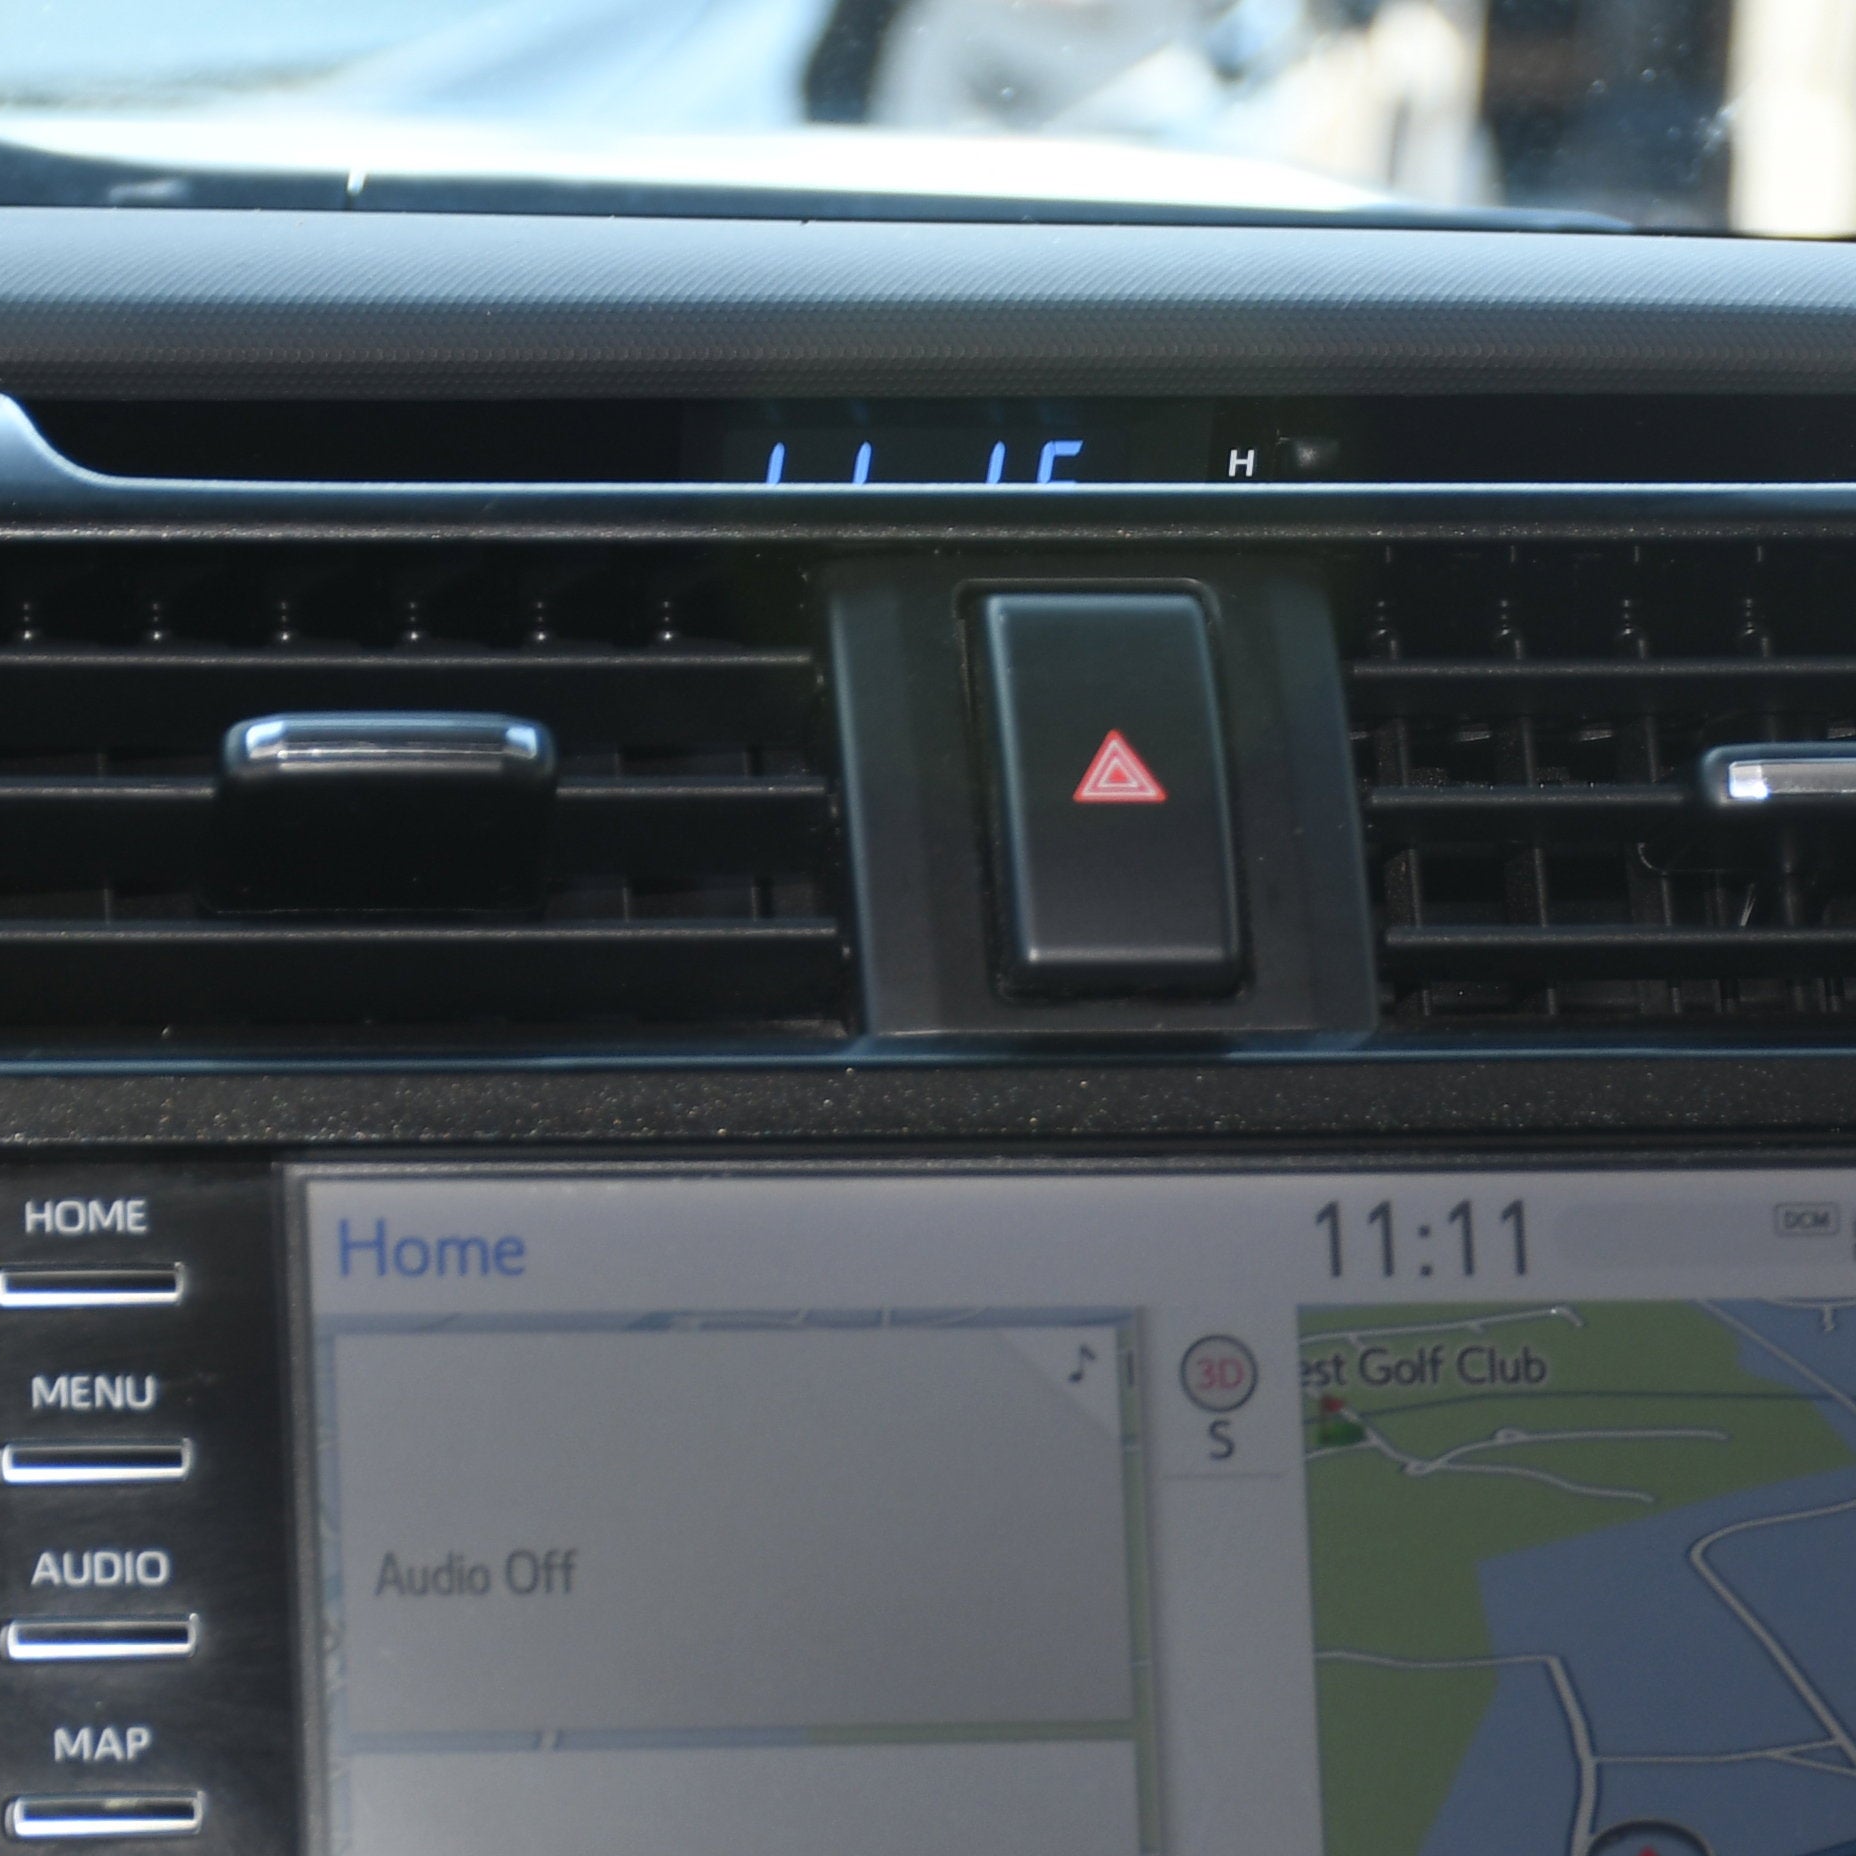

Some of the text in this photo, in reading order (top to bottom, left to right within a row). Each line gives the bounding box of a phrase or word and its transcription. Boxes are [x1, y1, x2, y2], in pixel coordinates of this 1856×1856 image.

[1227, 448, 1256, 478] H
[24, 1199, 148, 1235] HOME
[337, 1217, 528, 1278] Home
[1314, 1199, 1531, 1279] 11:11
[1194, 1356, 1245, 1391] 3D
[1358, 1343, 1444, 1387] Golf
[1456, 1343, 1548, 1386] Club
[30, 1374, 156, 1410] MENU
[1207, 1420, 1236, 1461] S
[30, 1550, 171, 1588] AUDIO
[374, 1547, 580, 1598] Audio Off
[53, 1726, 152, 1762] MAP
